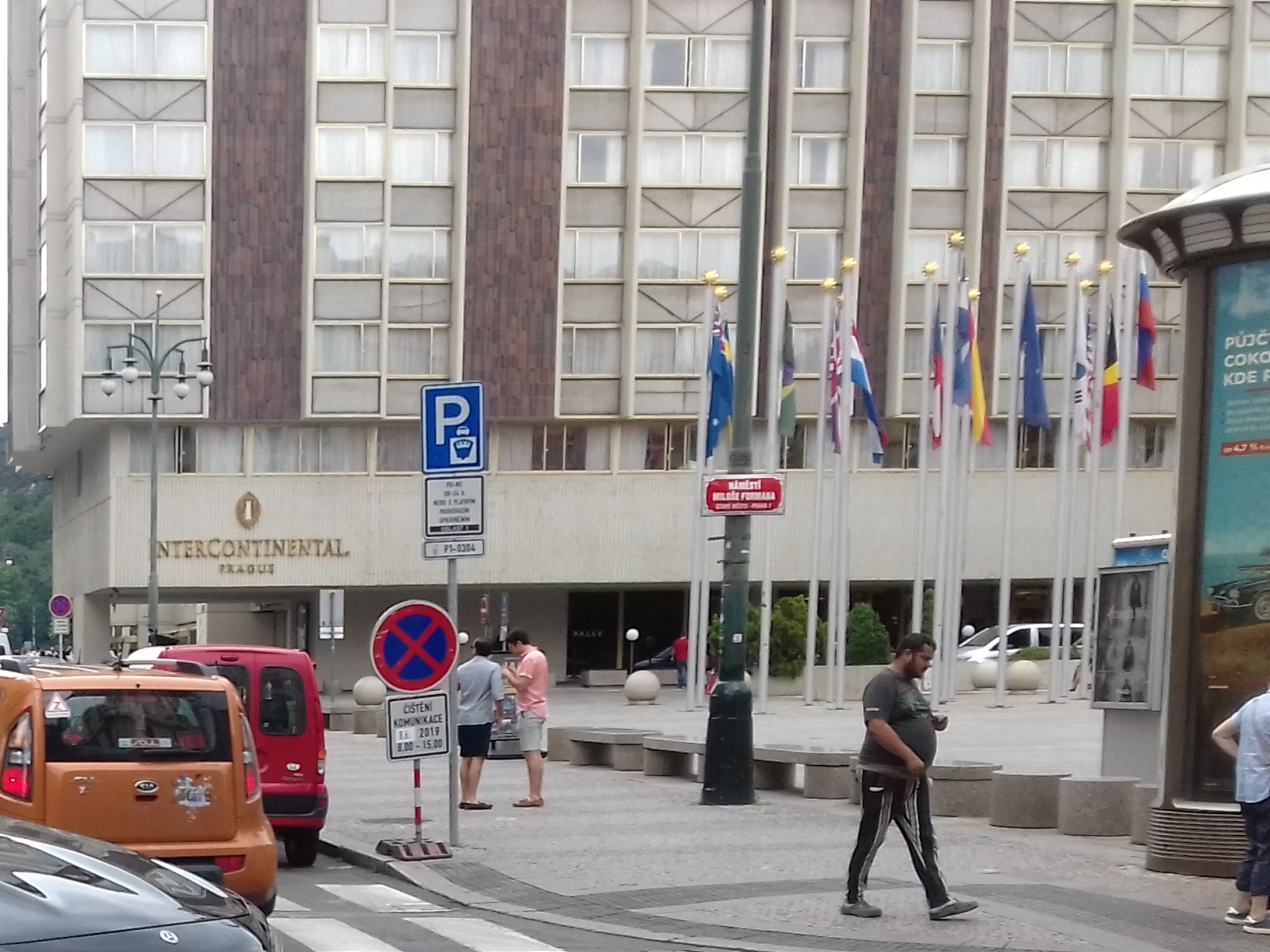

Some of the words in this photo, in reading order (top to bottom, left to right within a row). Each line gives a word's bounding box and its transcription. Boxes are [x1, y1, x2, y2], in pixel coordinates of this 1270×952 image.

[1224, 370, 1258, 386] KDE
[157, 539, 351, 558] NTERCONTINENTAL
[444, 543, 476, 553] P1-0304
[394, 714, 443, 728] KOMUNIKACE
[419, 727, 440, 738] 2019
